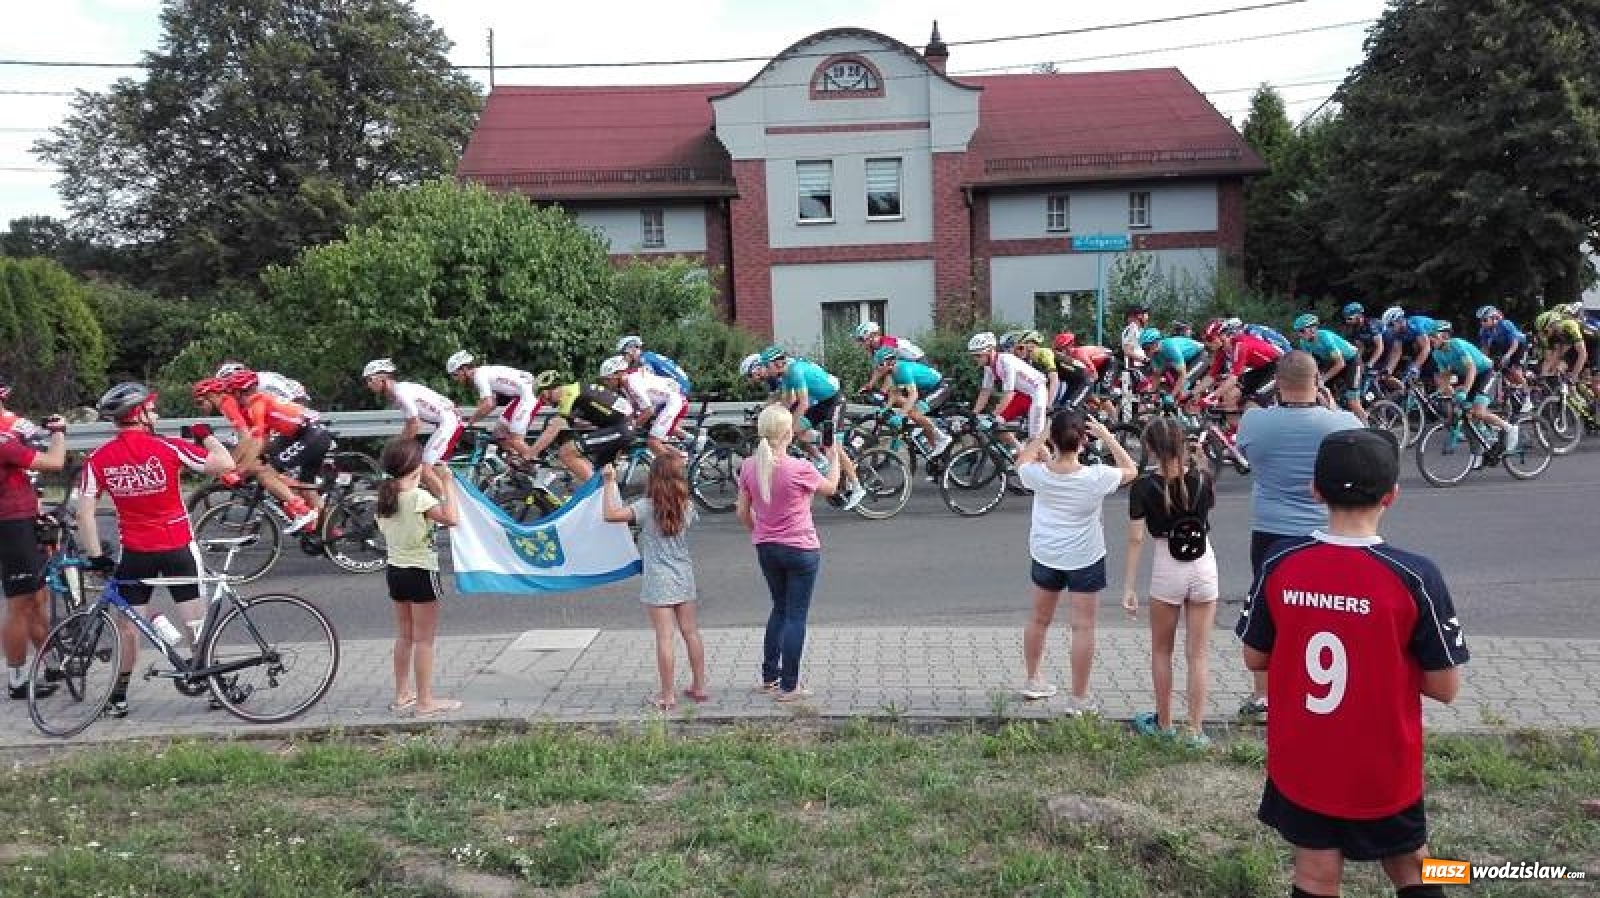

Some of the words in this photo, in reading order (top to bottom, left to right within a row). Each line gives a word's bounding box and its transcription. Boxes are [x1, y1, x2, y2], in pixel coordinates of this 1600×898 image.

[279, 442, 305, 462] CCC
[1283, 589, 1371, 615] WINNERS
[1305, 631, 1348, 715] 9
